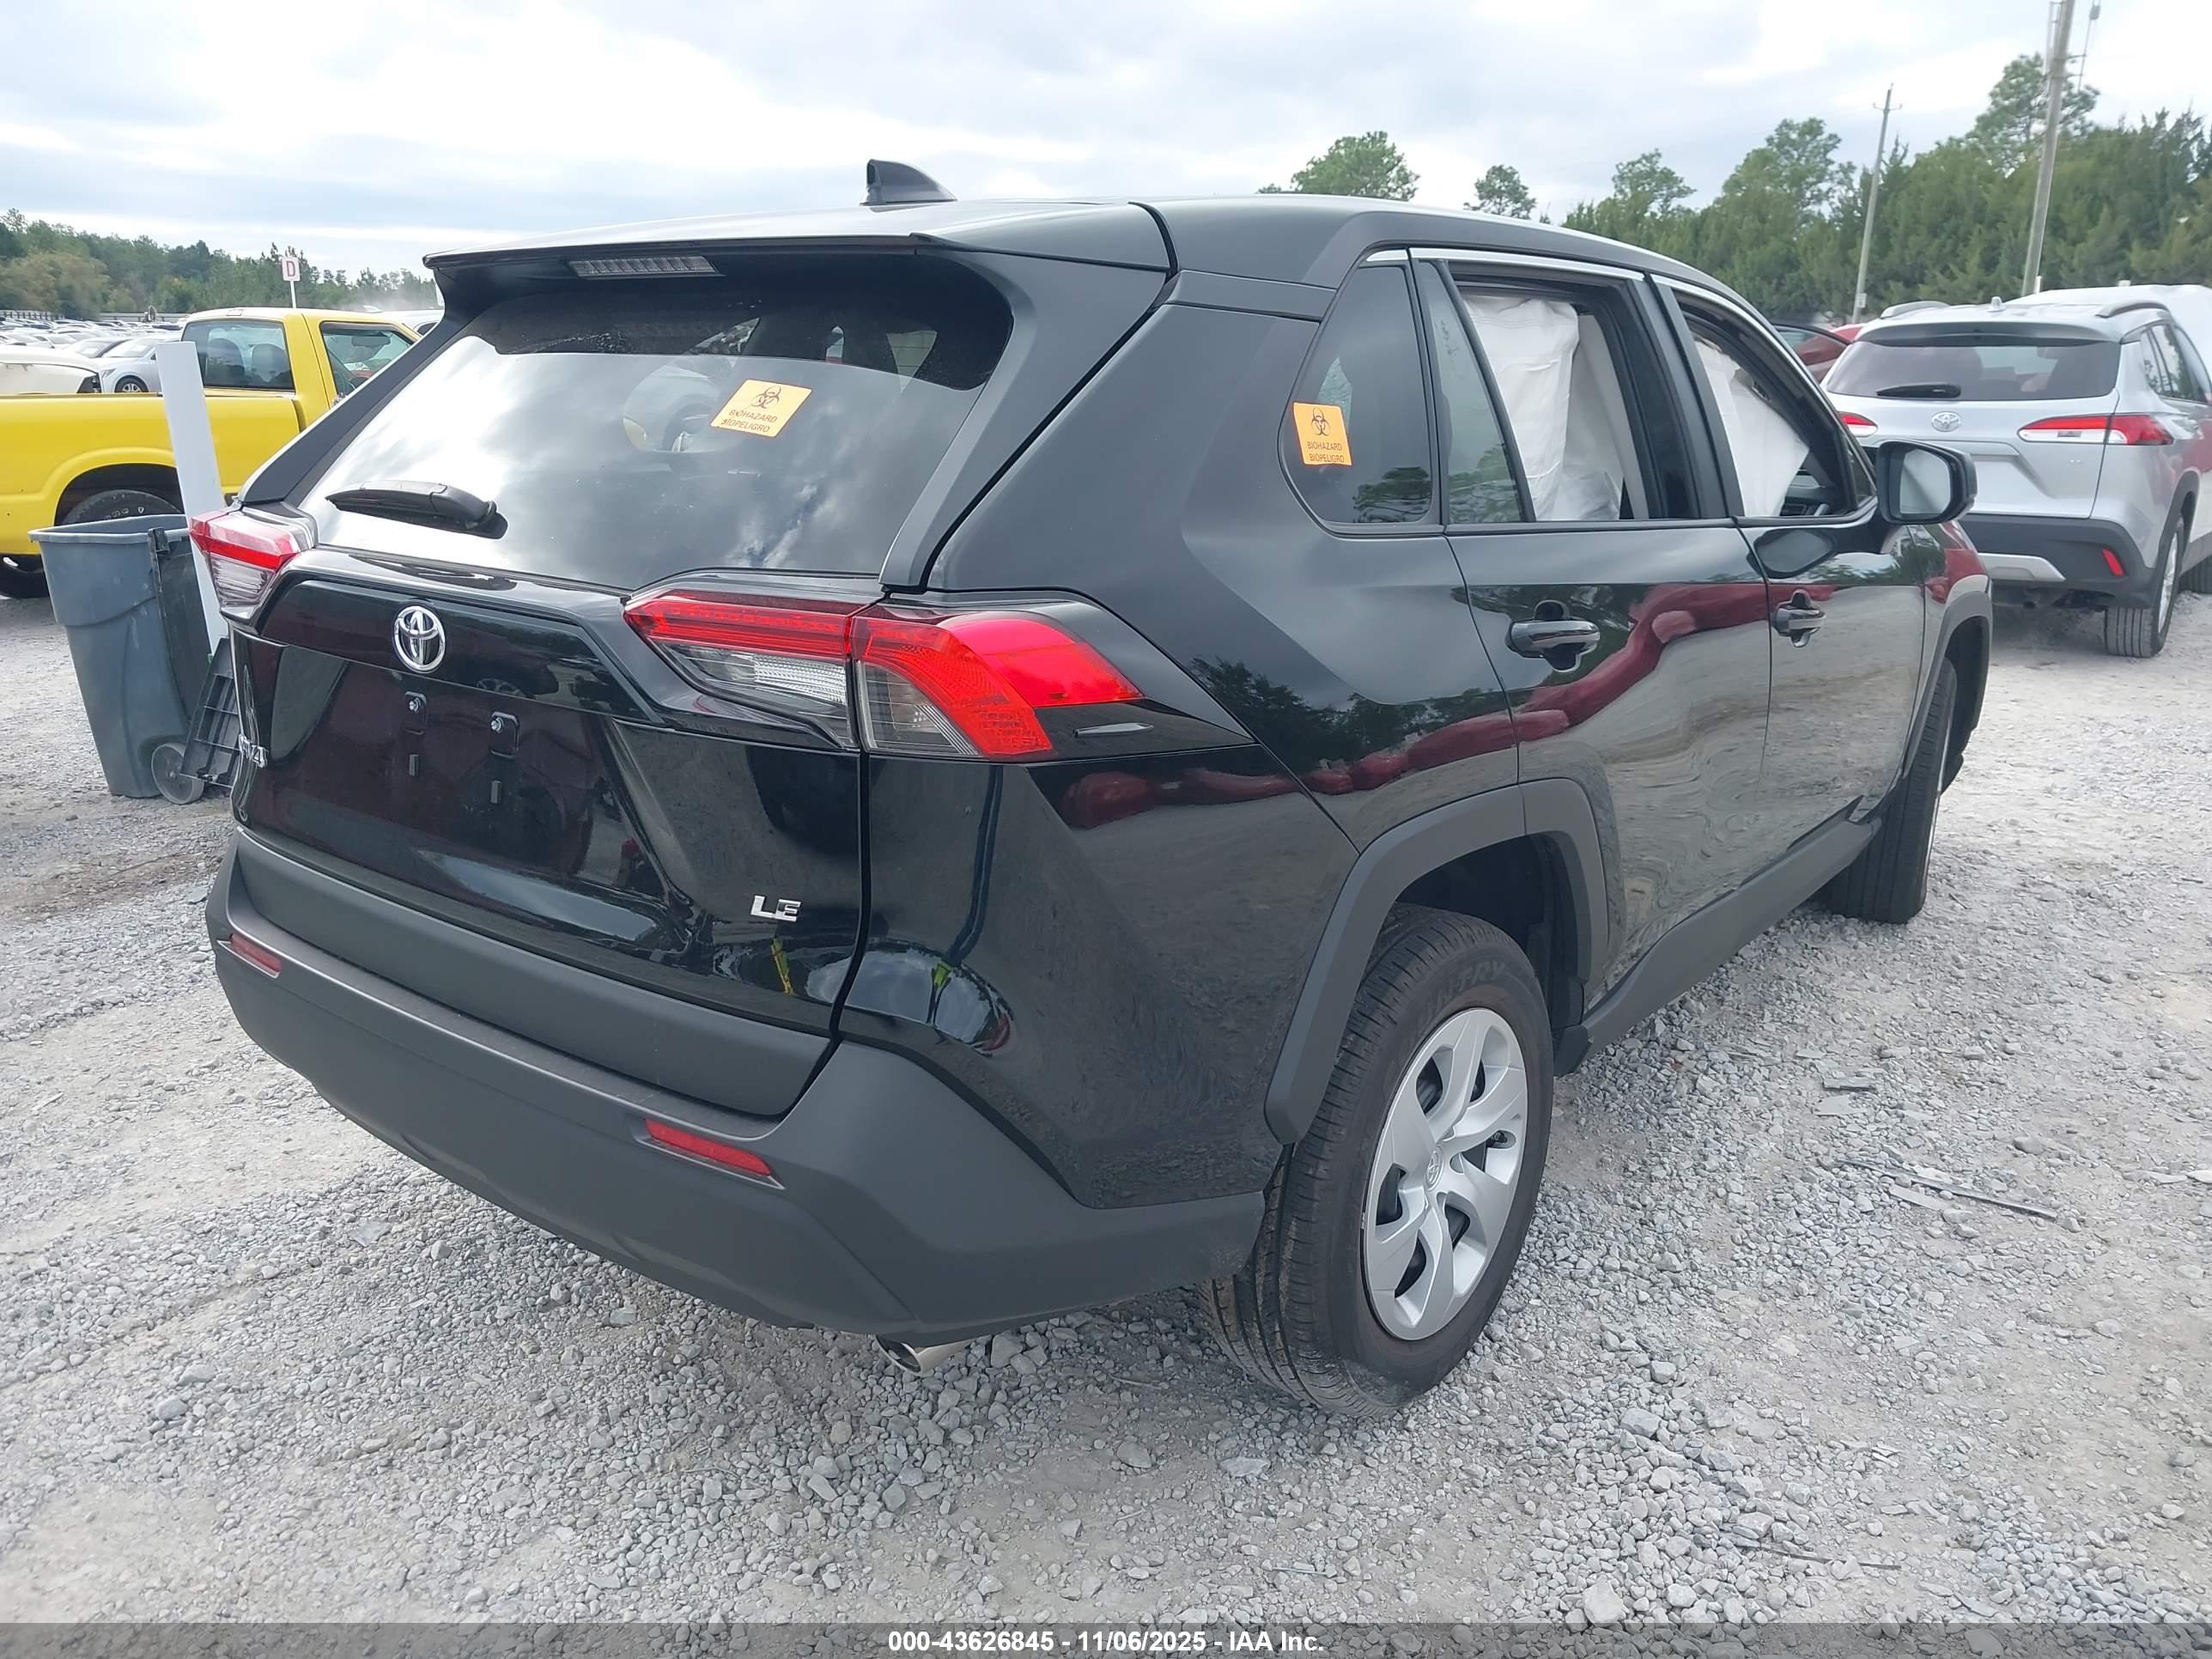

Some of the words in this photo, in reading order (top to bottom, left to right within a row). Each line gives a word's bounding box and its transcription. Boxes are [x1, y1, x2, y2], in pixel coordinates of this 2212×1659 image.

[286, 260, 296, 277] D
[728, 409, 778, 423] BIOHAZARD
[720, 418, 771, 433] BIOPELIGRO
[1307, 441, 1342, 451] BIOHAZARD
[1309, 453, 1345, 463] BIOPELIGRO
[750, 895, 802, 922] LE
